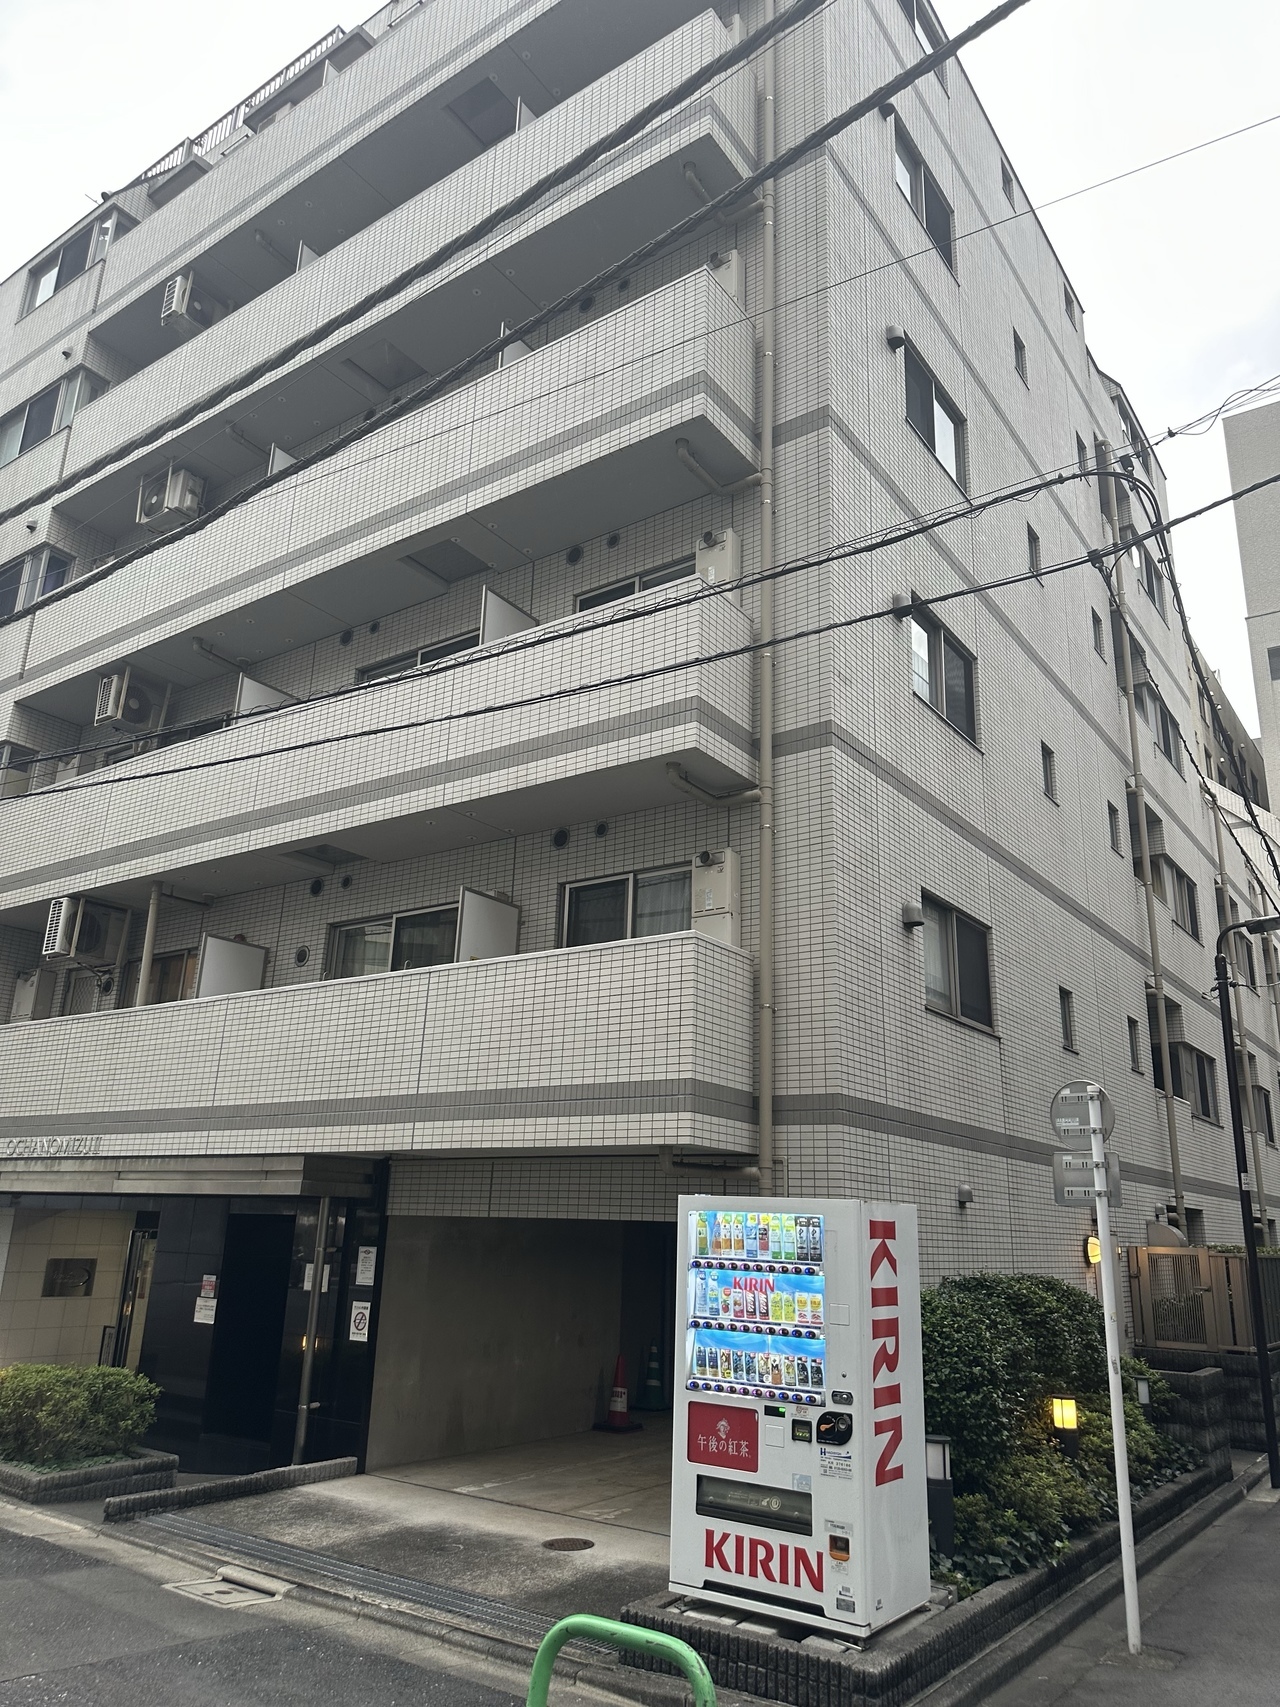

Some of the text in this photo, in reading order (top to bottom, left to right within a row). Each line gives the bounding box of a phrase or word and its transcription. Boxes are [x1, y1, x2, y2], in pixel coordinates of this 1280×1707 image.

[733, 1276, 775, 1293] KIRIN
[869, 1219, 904, 1486] KIRIN
[697, 1433, 750, 1459] 午後の紅茶
[705, 1528, 824, 1593] KIRIN
